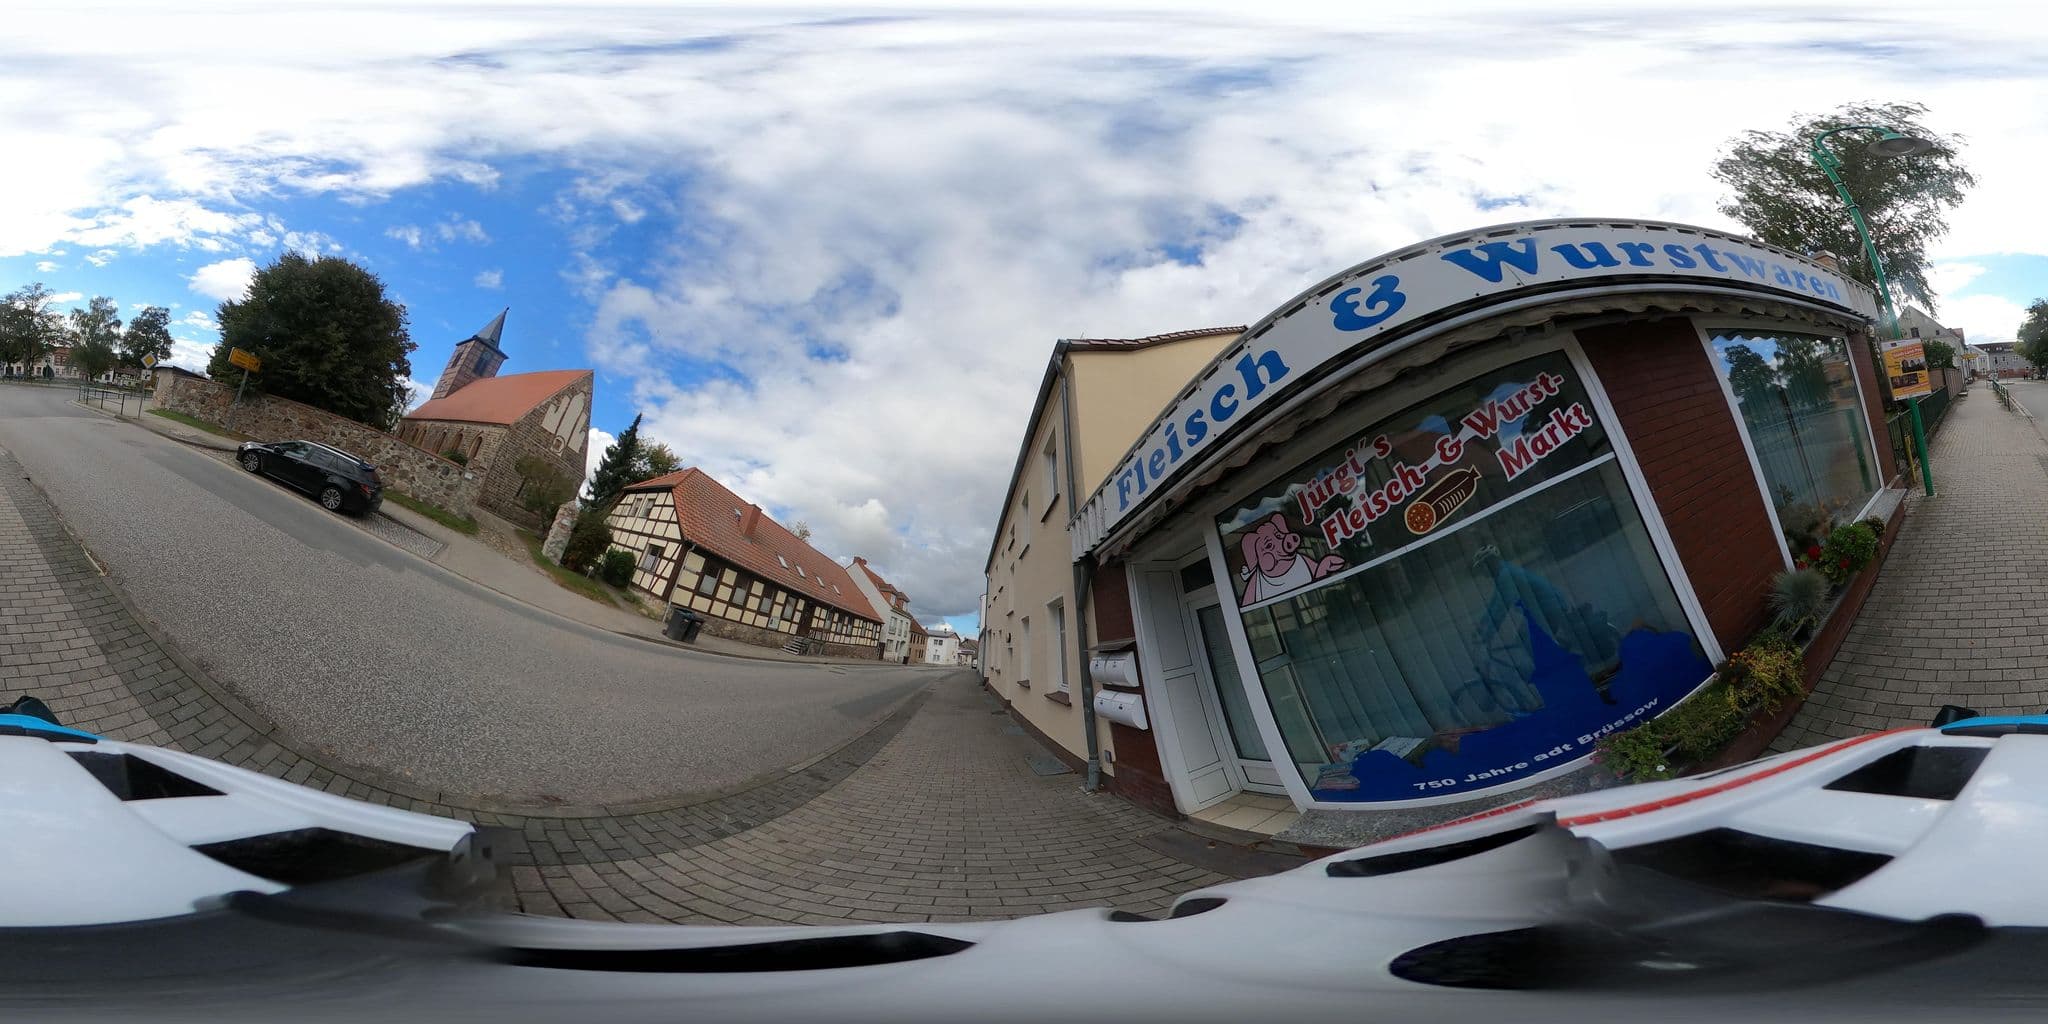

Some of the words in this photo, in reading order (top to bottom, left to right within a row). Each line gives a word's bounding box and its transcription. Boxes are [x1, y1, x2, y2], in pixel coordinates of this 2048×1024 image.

[1116, 350, 1290, 512] Fleisch
[1330, 275, 1406, 331] &
[1441, 237, 1841, 300] Wurstwaren
[1496, 402, 1592, 481] Markt
[1322, 462, 1428, 548] Fleisch-
[1435, 437, 1463, 464] &
[1461, 372, 1564, 438] Wurst-
[1413, 778, 1457, 790] 750
[1464, 761, 1529, 783] Jahre
[1533, 743, 1573, 762] adt
[1577, 697, 1659, 745] Brüssow
